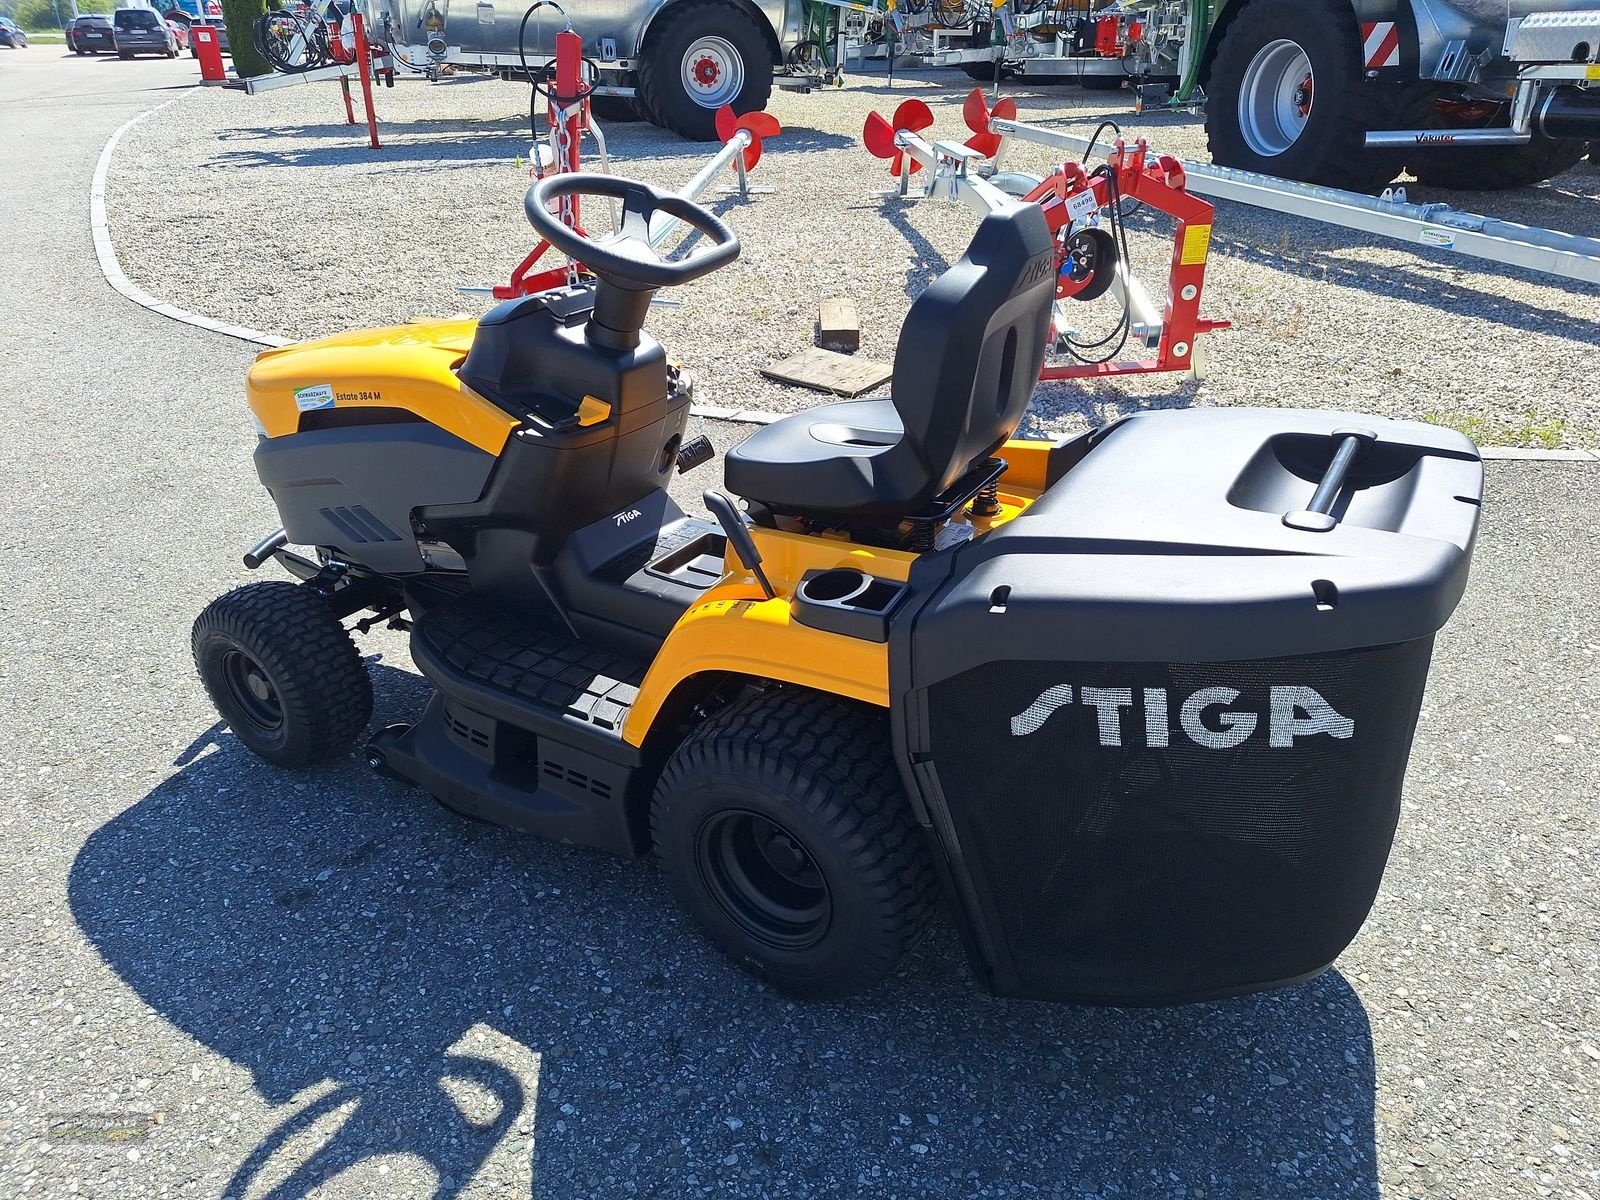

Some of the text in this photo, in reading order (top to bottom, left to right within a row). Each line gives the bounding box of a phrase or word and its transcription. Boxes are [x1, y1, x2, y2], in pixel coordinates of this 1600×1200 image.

[1415, 133, 1456, 144] Vakutec
[1072, 196, 1093, 210] 68490
[336, 391, 381, 401] Estate 384 M
[612, 509, 642, 527] STIGA
[1010, 683, 1355, 749] STIGA
